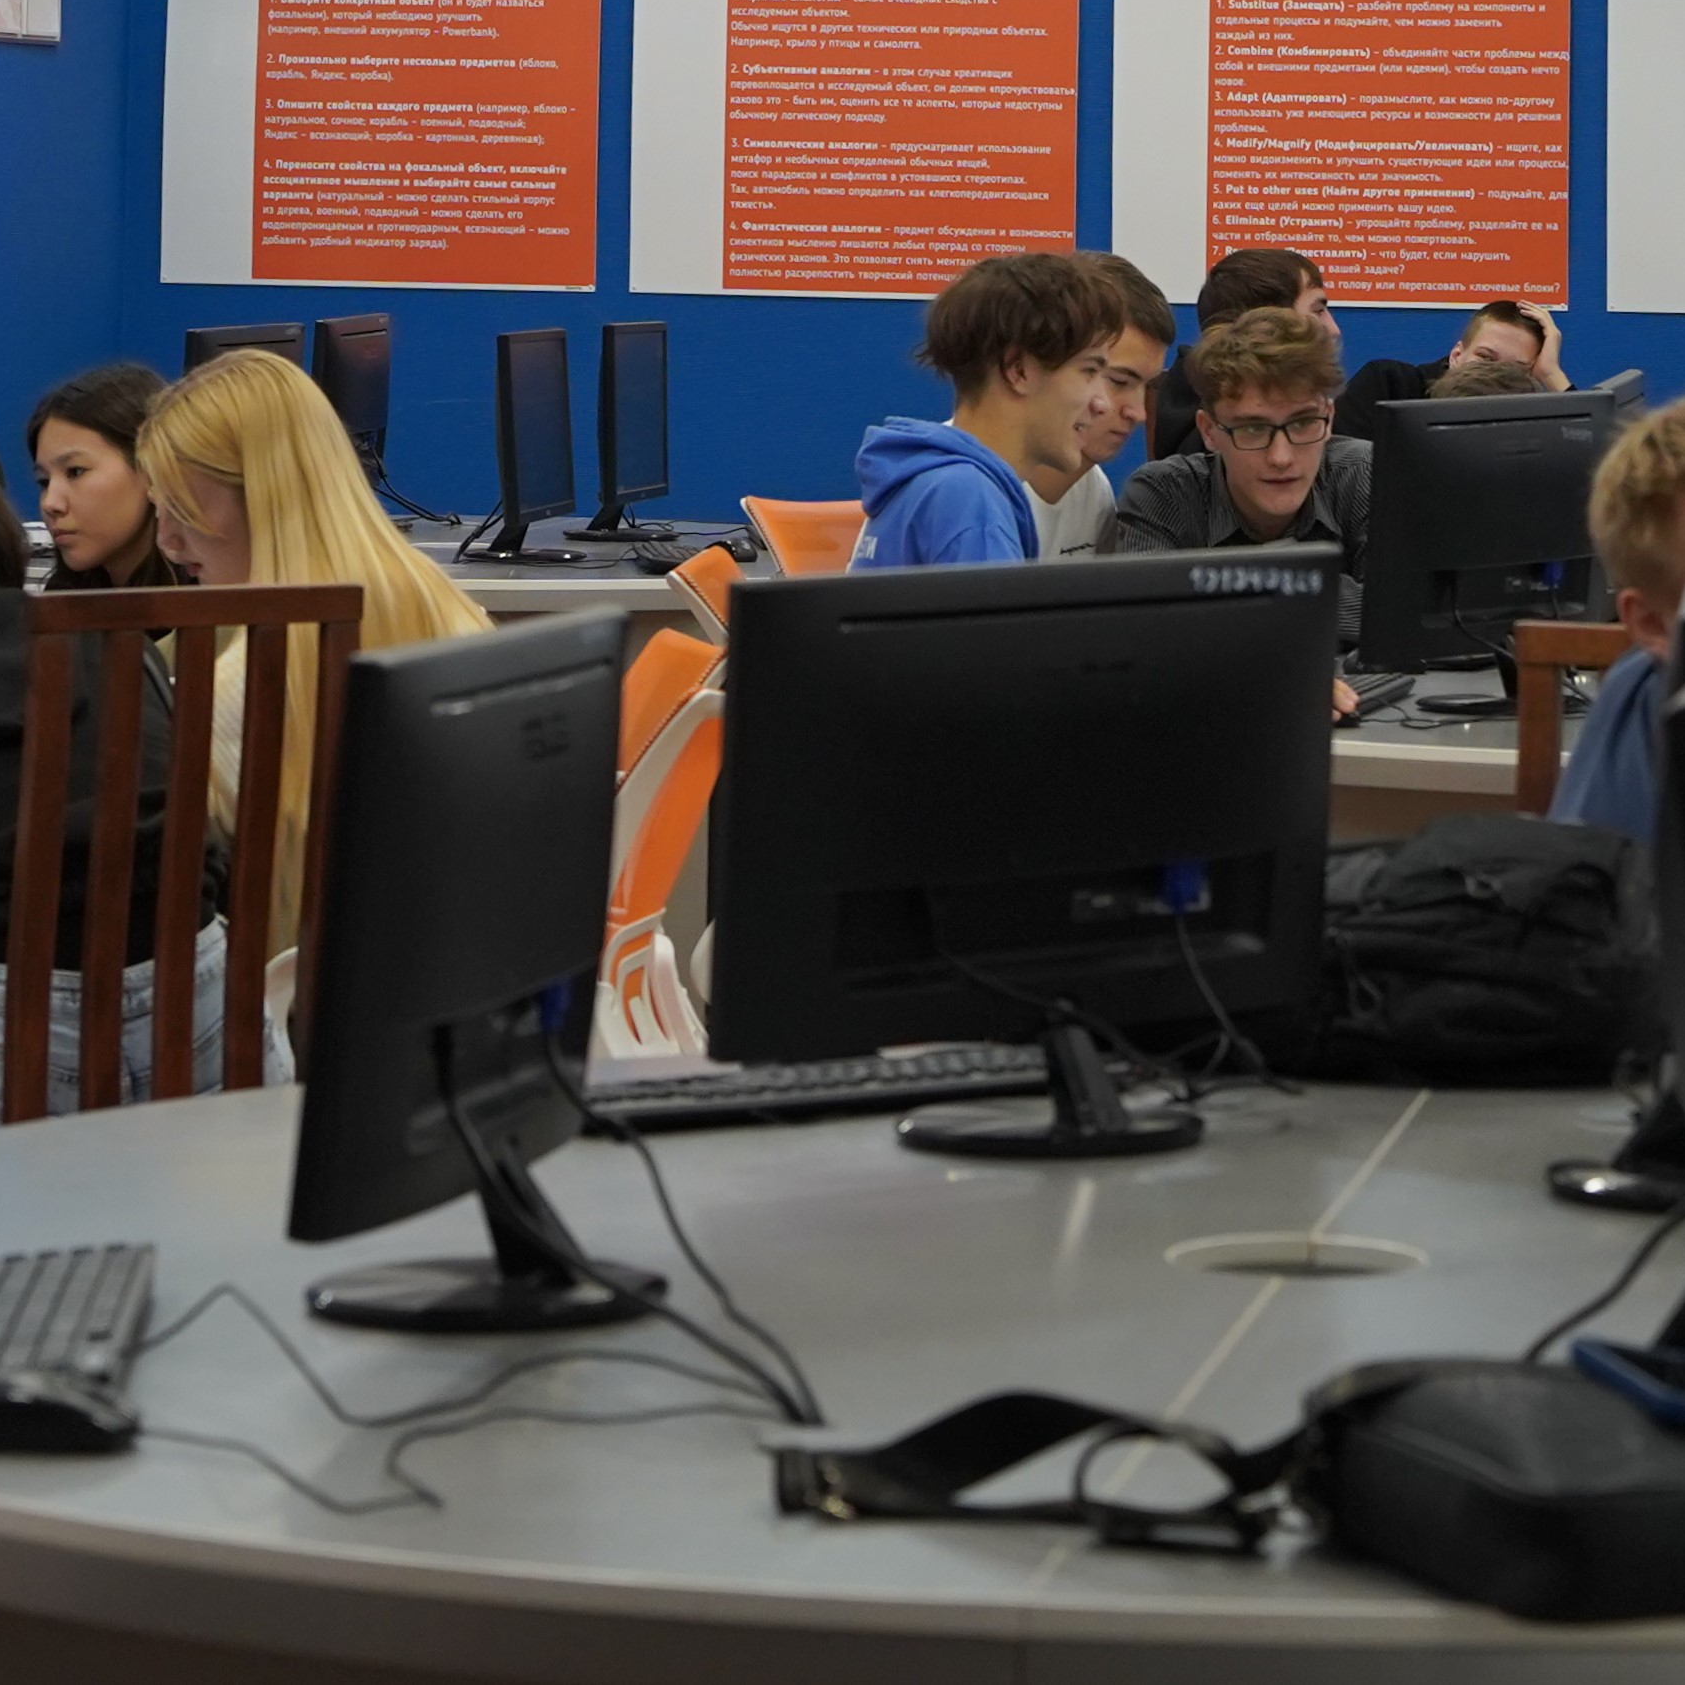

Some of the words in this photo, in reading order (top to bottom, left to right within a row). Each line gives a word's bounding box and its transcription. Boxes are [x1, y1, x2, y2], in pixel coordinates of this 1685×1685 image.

[1281, 0, 1345, 12] (Замещать)
[1226, 44, 1274, 56] Combine
[1275, 45, 1371, 59] (Комбинировать)
